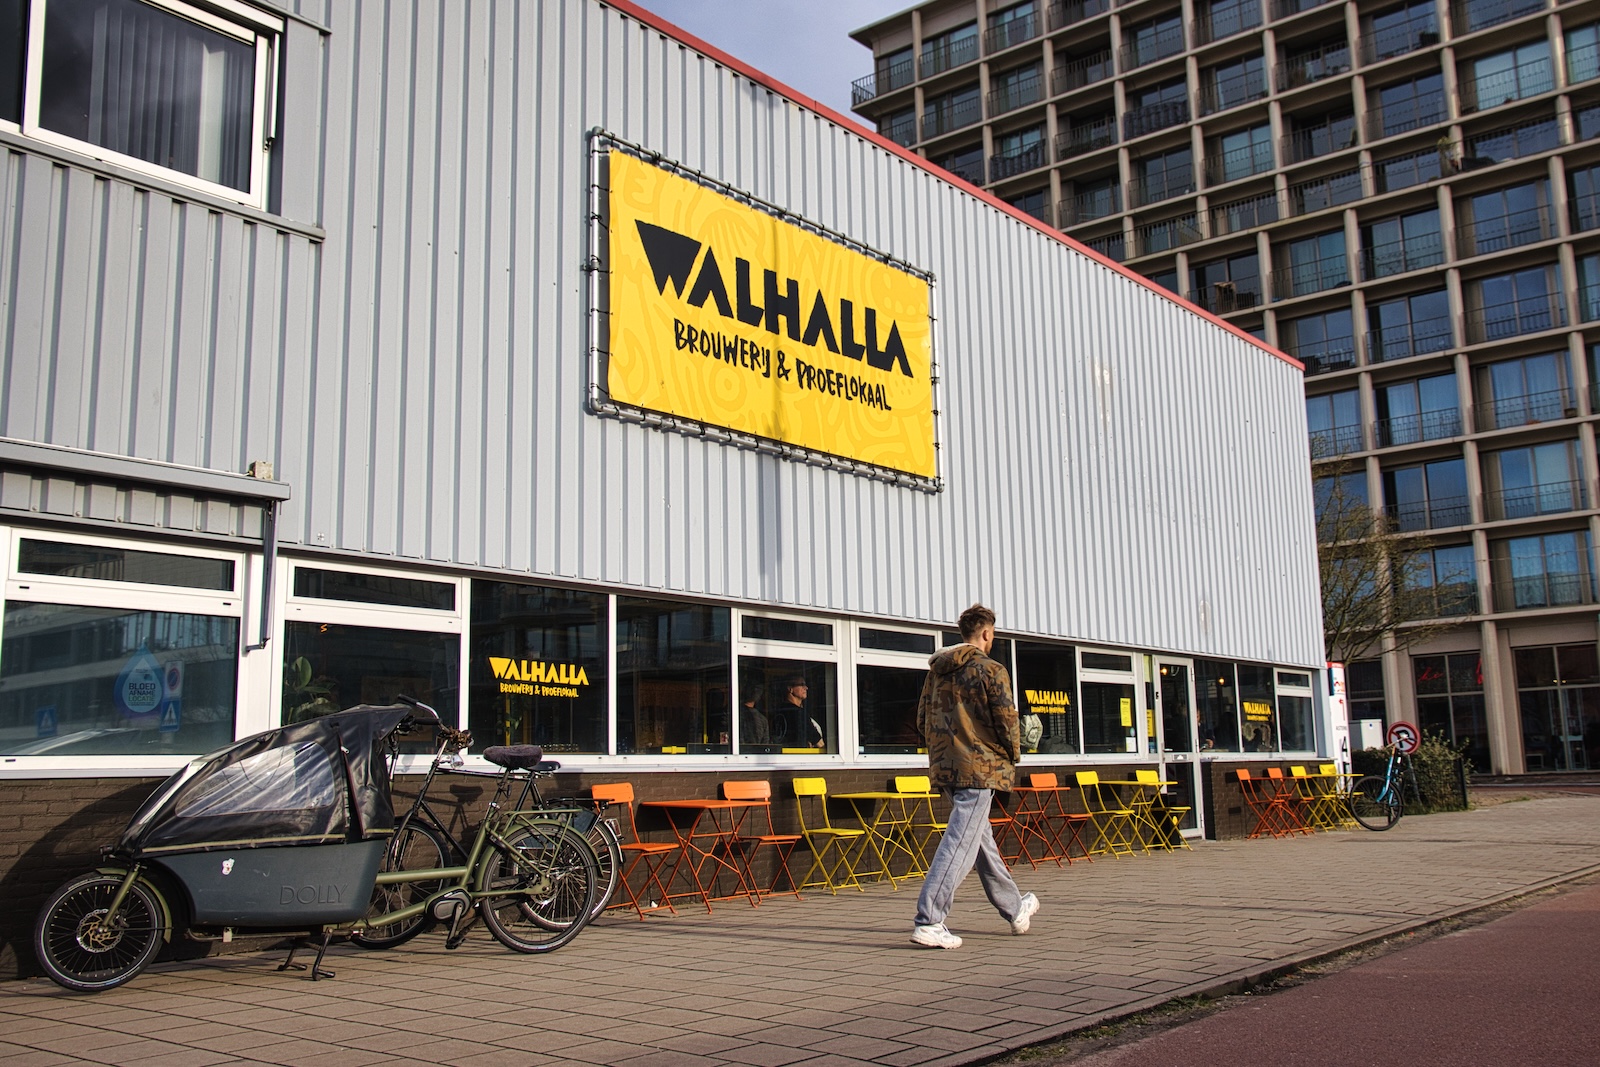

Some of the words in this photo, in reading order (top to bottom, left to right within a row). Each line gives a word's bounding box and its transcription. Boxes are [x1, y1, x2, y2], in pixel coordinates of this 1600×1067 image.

[635, 219, 913, 378] WALHALLA
[674, 318, 771, 378] BROUWERIJ
[777, 349, 791, 381] &
[797, 357, 892, 411] PROEFLOKAAL
[488, 657, 589, 686] WALHALLA
[1024, 690, 1070, 705] WALHALLA
[280, 884, 349, 904] DOLLY
